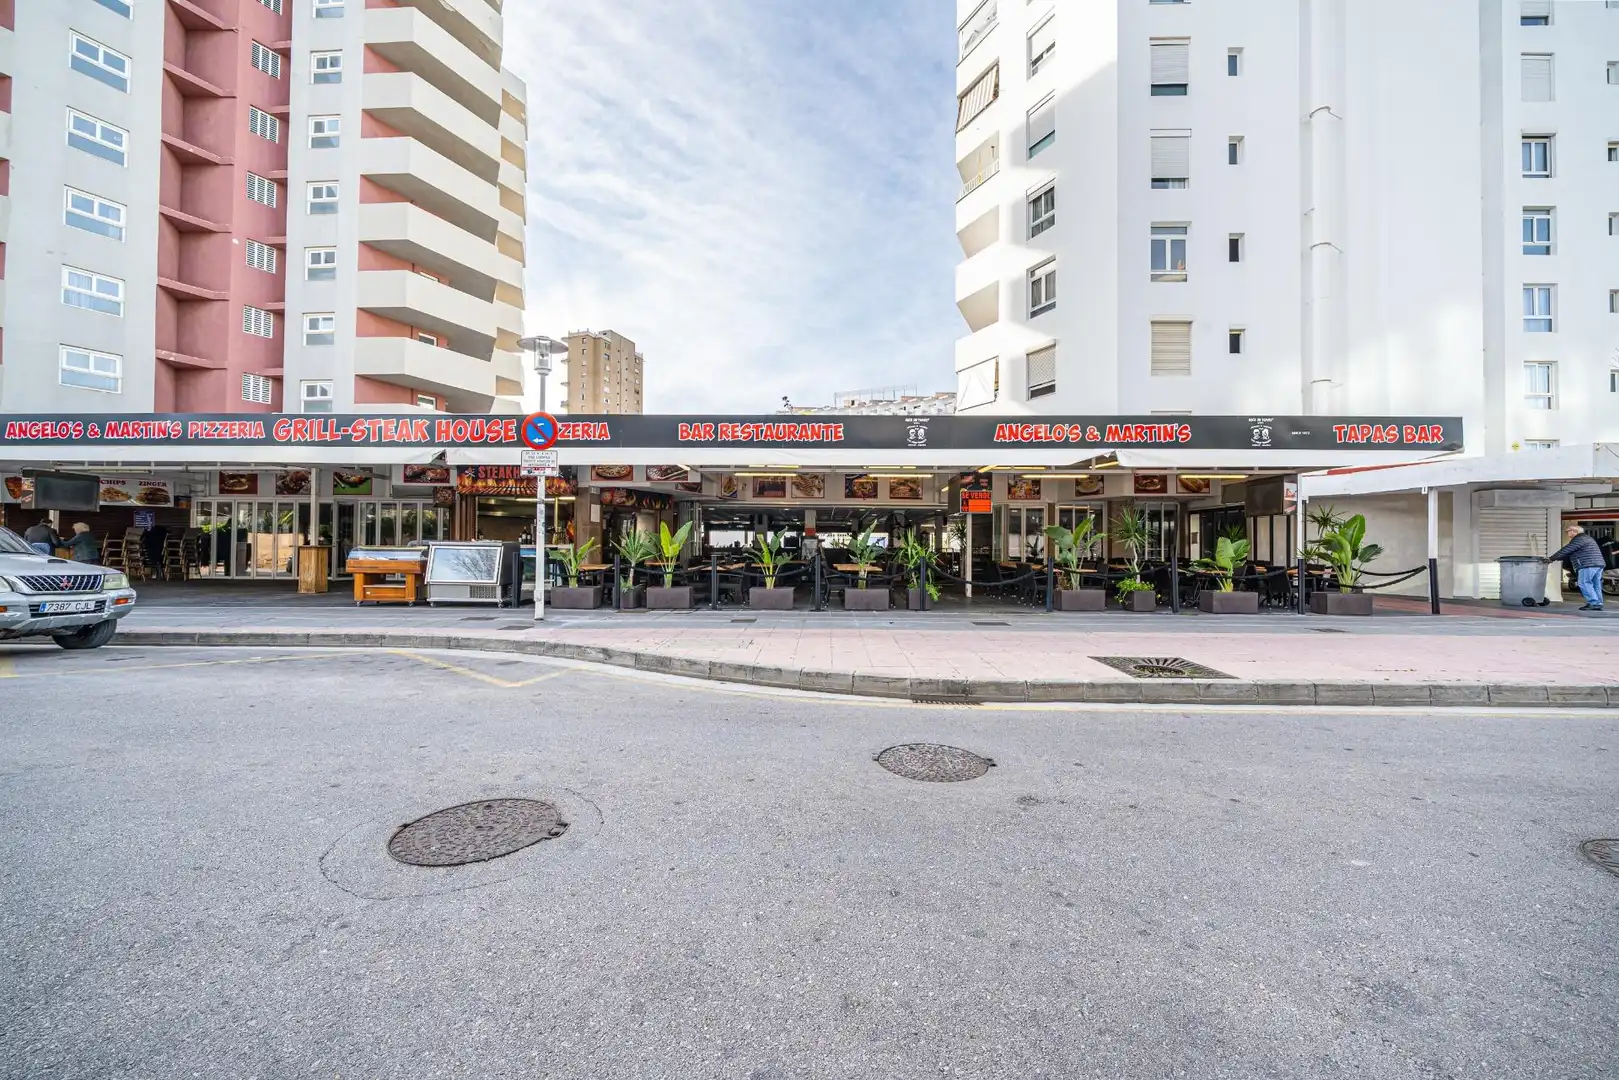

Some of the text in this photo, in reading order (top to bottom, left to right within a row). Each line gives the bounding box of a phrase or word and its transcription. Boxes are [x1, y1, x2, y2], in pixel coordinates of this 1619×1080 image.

[5, 420, 265, 439] ANGELO'S & MARTIN'S PIZZERIA
[273, 418, 517, 443] GRILL-STEAK HOUSE
[557, 421, 611, 440] ZERIA
[678, 423, 844, 441] BAR RESTAURANTE
[994, 423, 1191, 442] ANGELO'S & MARTIN'S
[1333, 424, 1444, 443] TAPAS BAR
[46, 602, 92, 612] 7387 CJL
